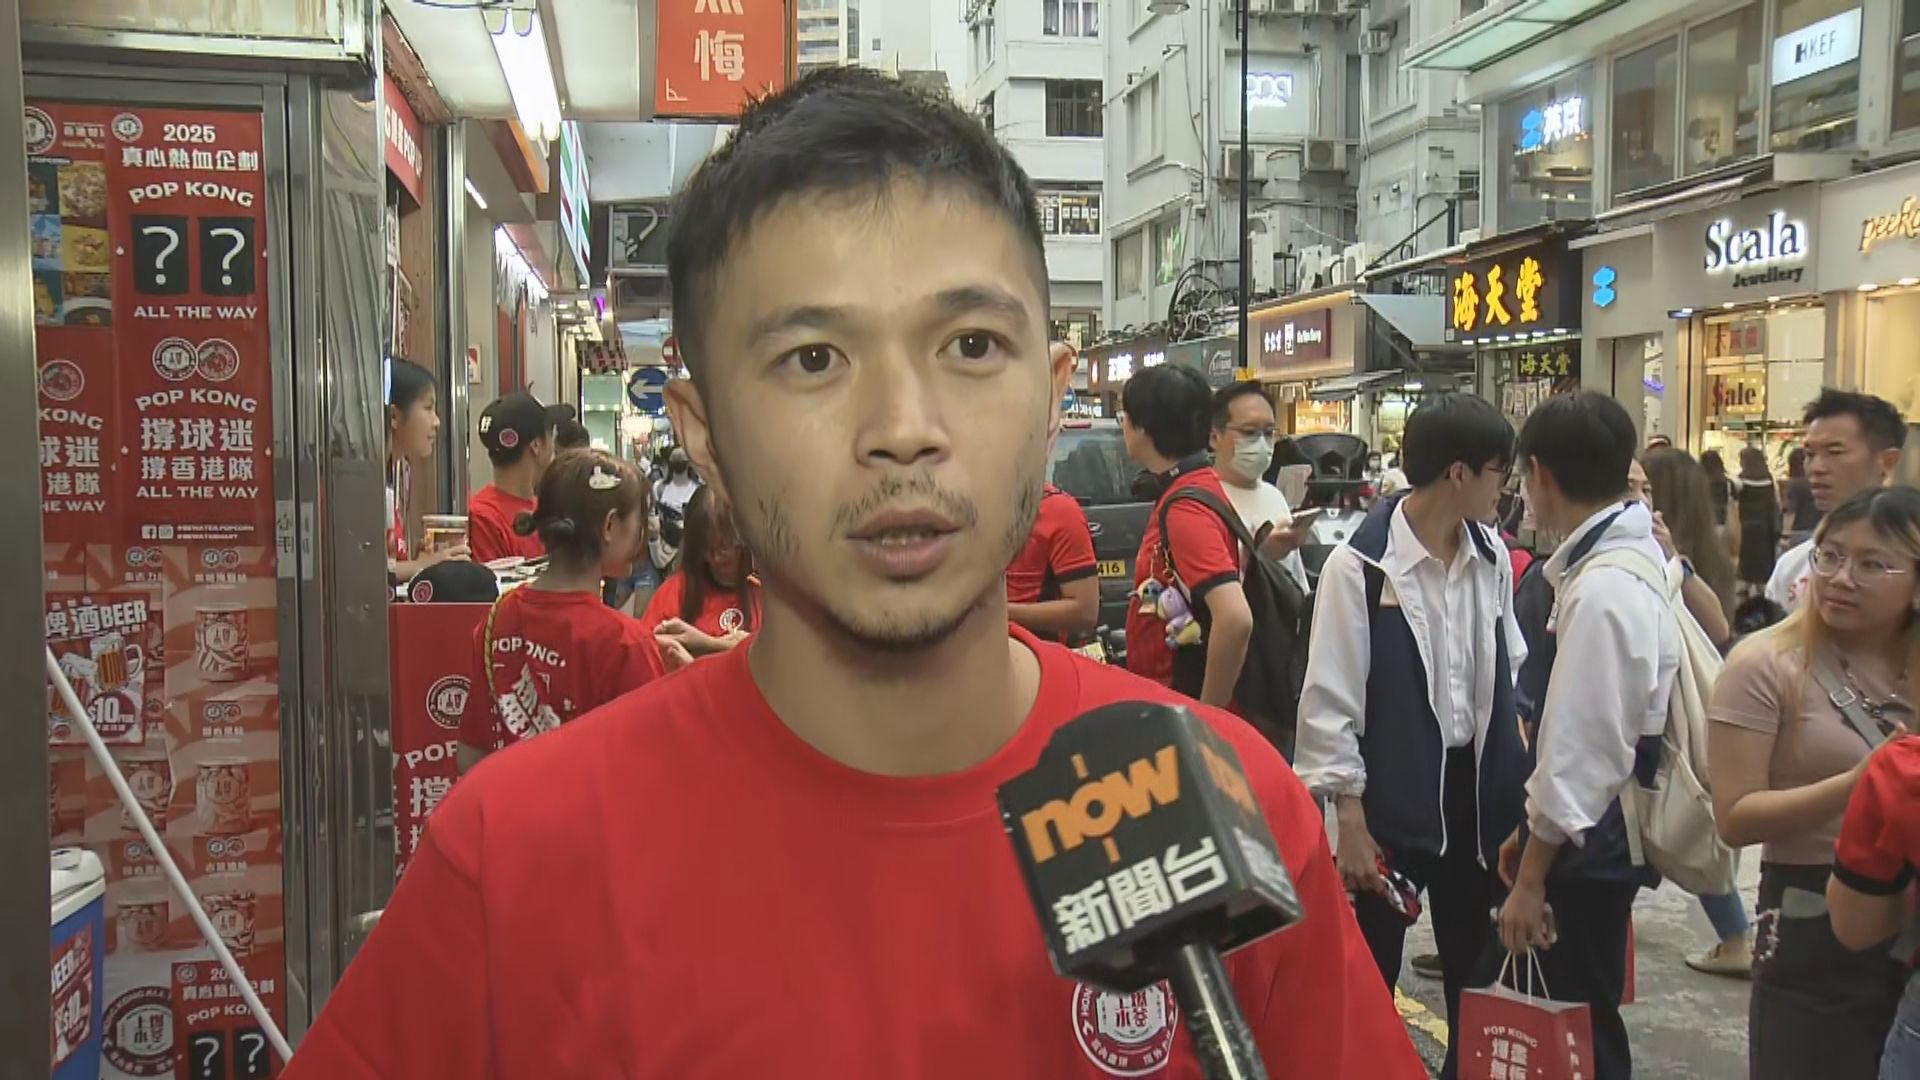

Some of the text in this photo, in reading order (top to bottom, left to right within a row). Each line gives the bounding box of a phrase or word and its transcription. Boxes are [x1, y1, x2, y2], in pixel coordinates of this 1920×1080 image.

[163, 123, 216, 144] 2025
[128, 181, 254, 207] POP KONG
[1704, 210, 1801, 271] Scala
[1733, 265, 1805, 289] Jewellery
[1453, 256, 1543, 331] 海天堂
[133, 305, 258, 320] ALL THE WAY
[136, 388, 258, 413] POP KONG
[1712, 381, 1757, 407] Sale
[139, 417, 254, 452] 撐球迷
[140, 455, 254, 482] 撐香港隊
[47, 472, 101, 496] 港隊
[136, 486, 259, 499] ALL THE WAY
[65, 500, 106, 513] WAY
[101, 600, 148, 629] BEER
[1021, 744, 1180, 865] now
[1052, 835, 1229, 956] 新聞台
[186, 1006, 220, 1024] POP
